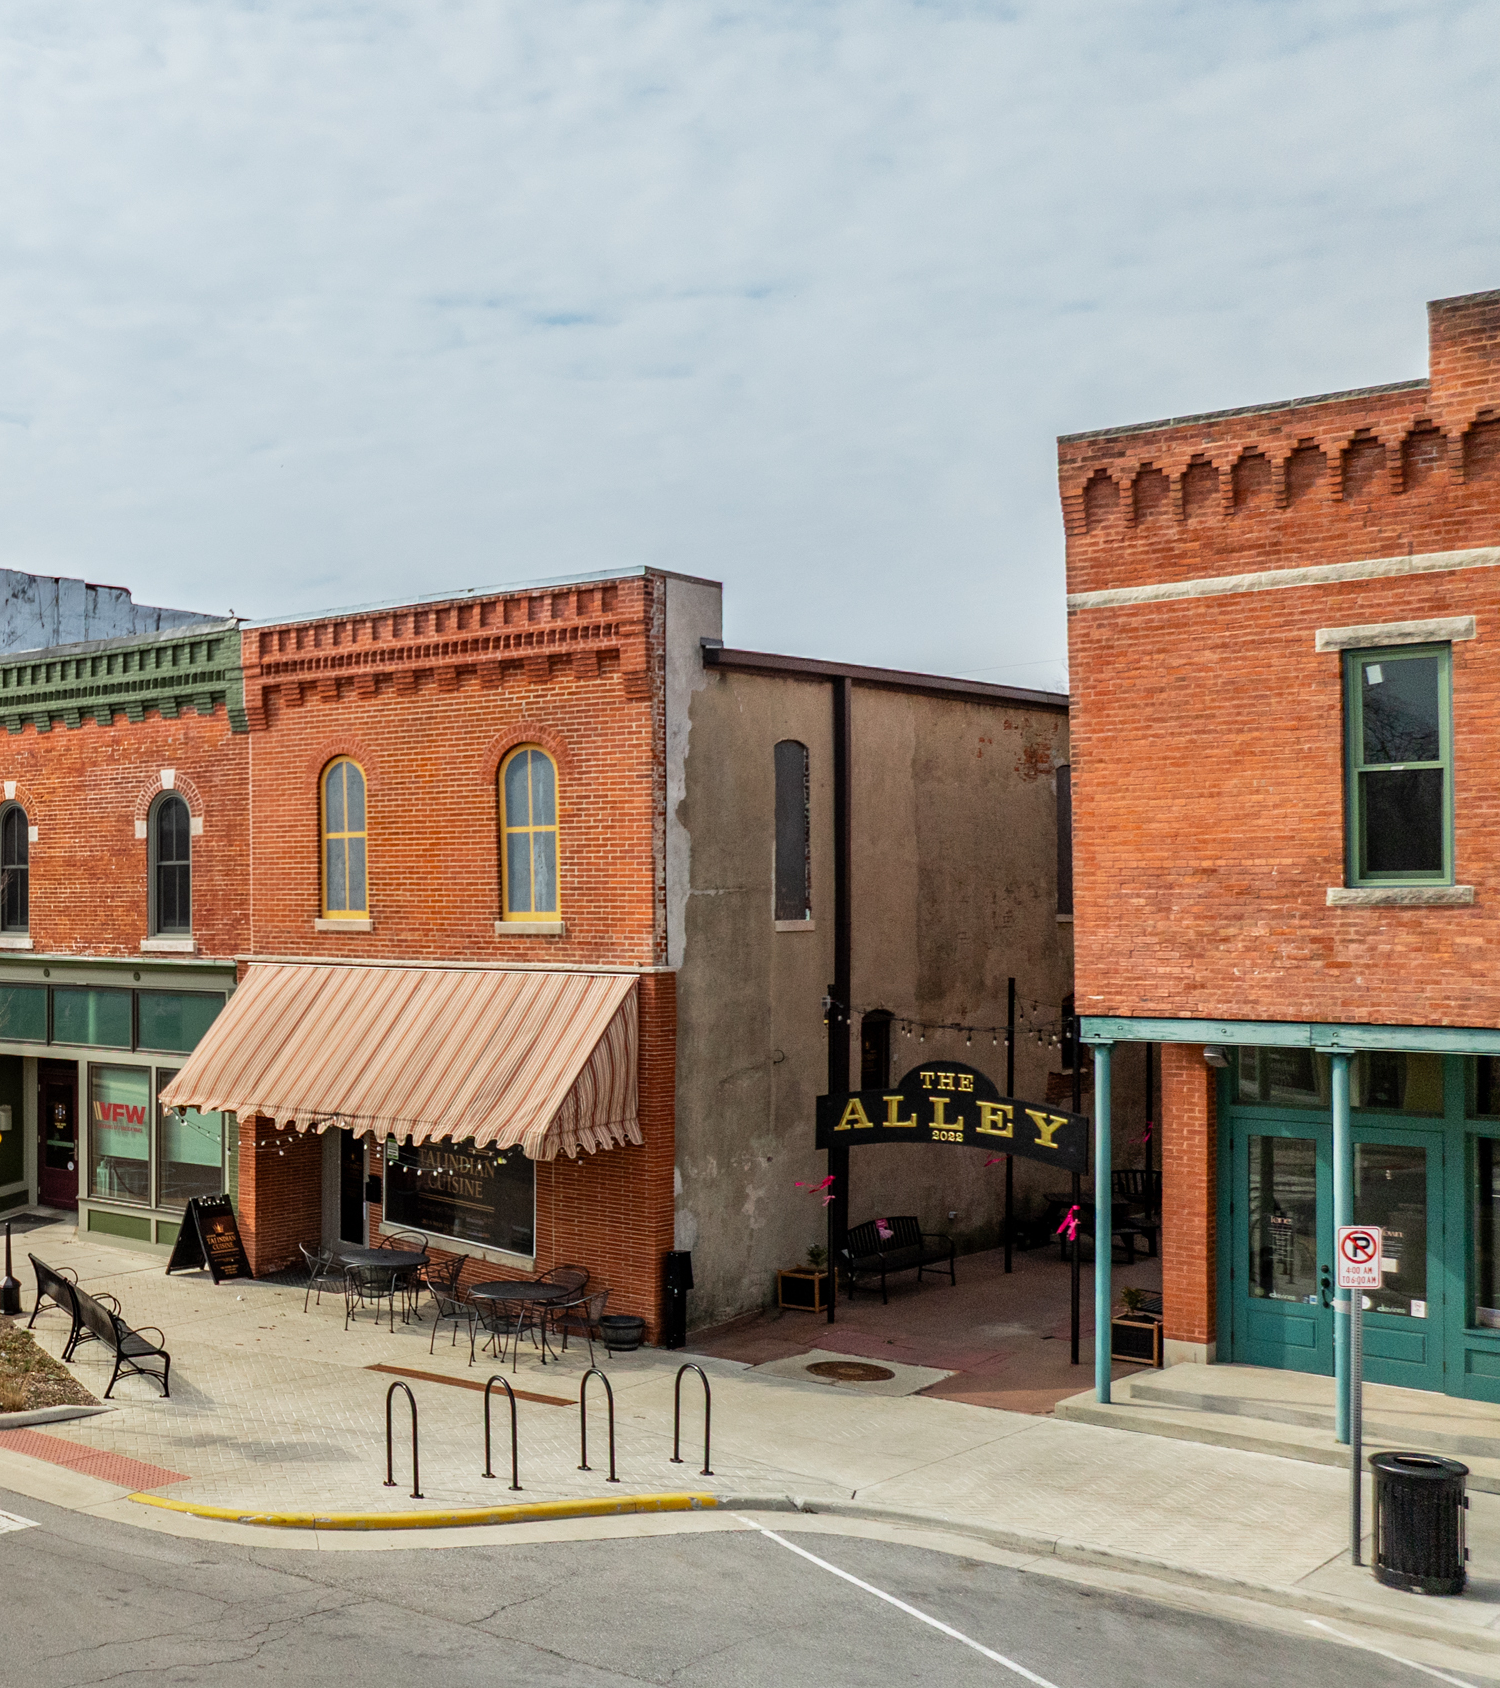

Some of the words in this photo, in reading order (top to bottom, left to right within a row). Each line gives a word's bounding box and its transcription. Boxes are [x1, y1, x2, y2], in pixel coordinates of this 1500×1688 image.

[920, 1072, 974, 1092] THE
[100, 1101, 146, 1125] VFW
[834, 1096, 1068, 1148] ALLEY
[932, 1131, 964, 1142] 2022
[444, 1152, 495, 1179] INDIAN
[428, 1172, 483, 1198] CUISINE
[1342, 1276, 1350, 1284] TO
[1351, 1276, 1366, 1284] 6:00
[1367, 1276, 1377, 1284] AM
[1346, 1266, 1361, 1275] 4:00
[1363, 1266, 1373, 1275] AM
